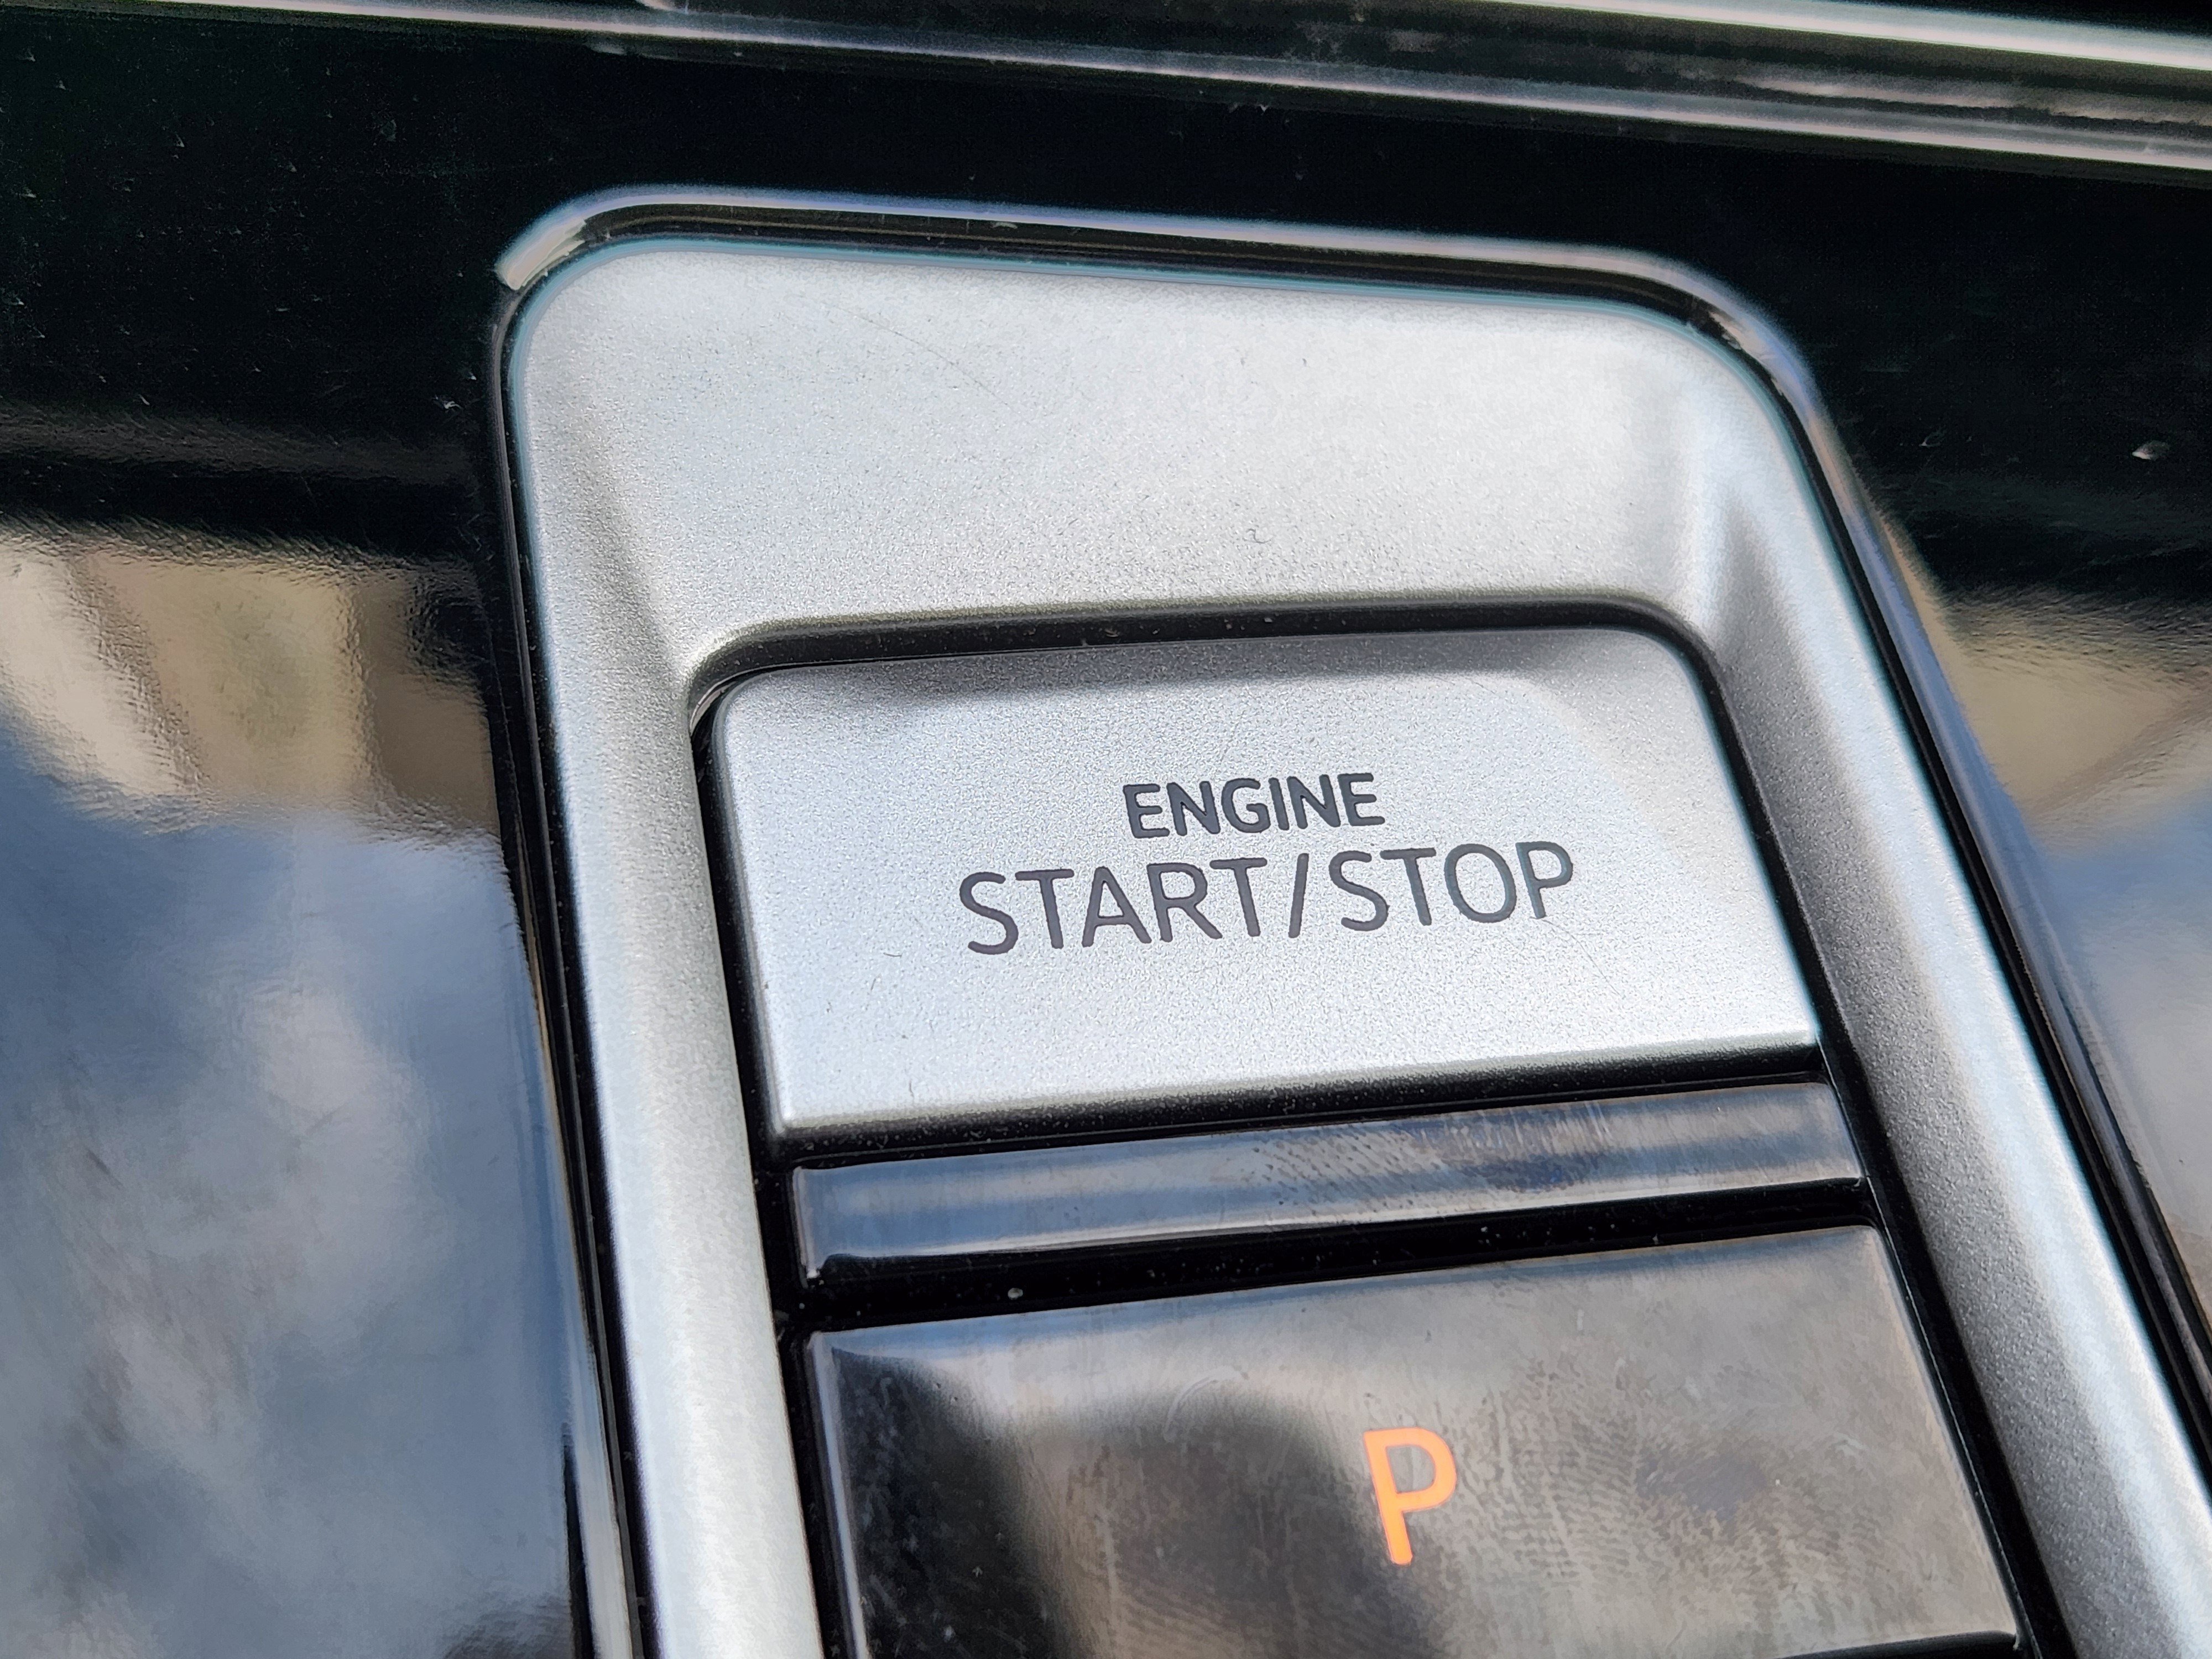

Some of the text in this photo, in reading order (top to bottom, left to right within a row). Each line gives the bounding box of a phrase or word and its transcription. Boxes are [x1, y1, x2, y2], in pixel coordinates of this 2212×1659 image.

[1123, 772, 1385, 838] ENGINE
[959, 841, 1574, 955] START/STOP
[1363, 1426, 1457, 1566] P
